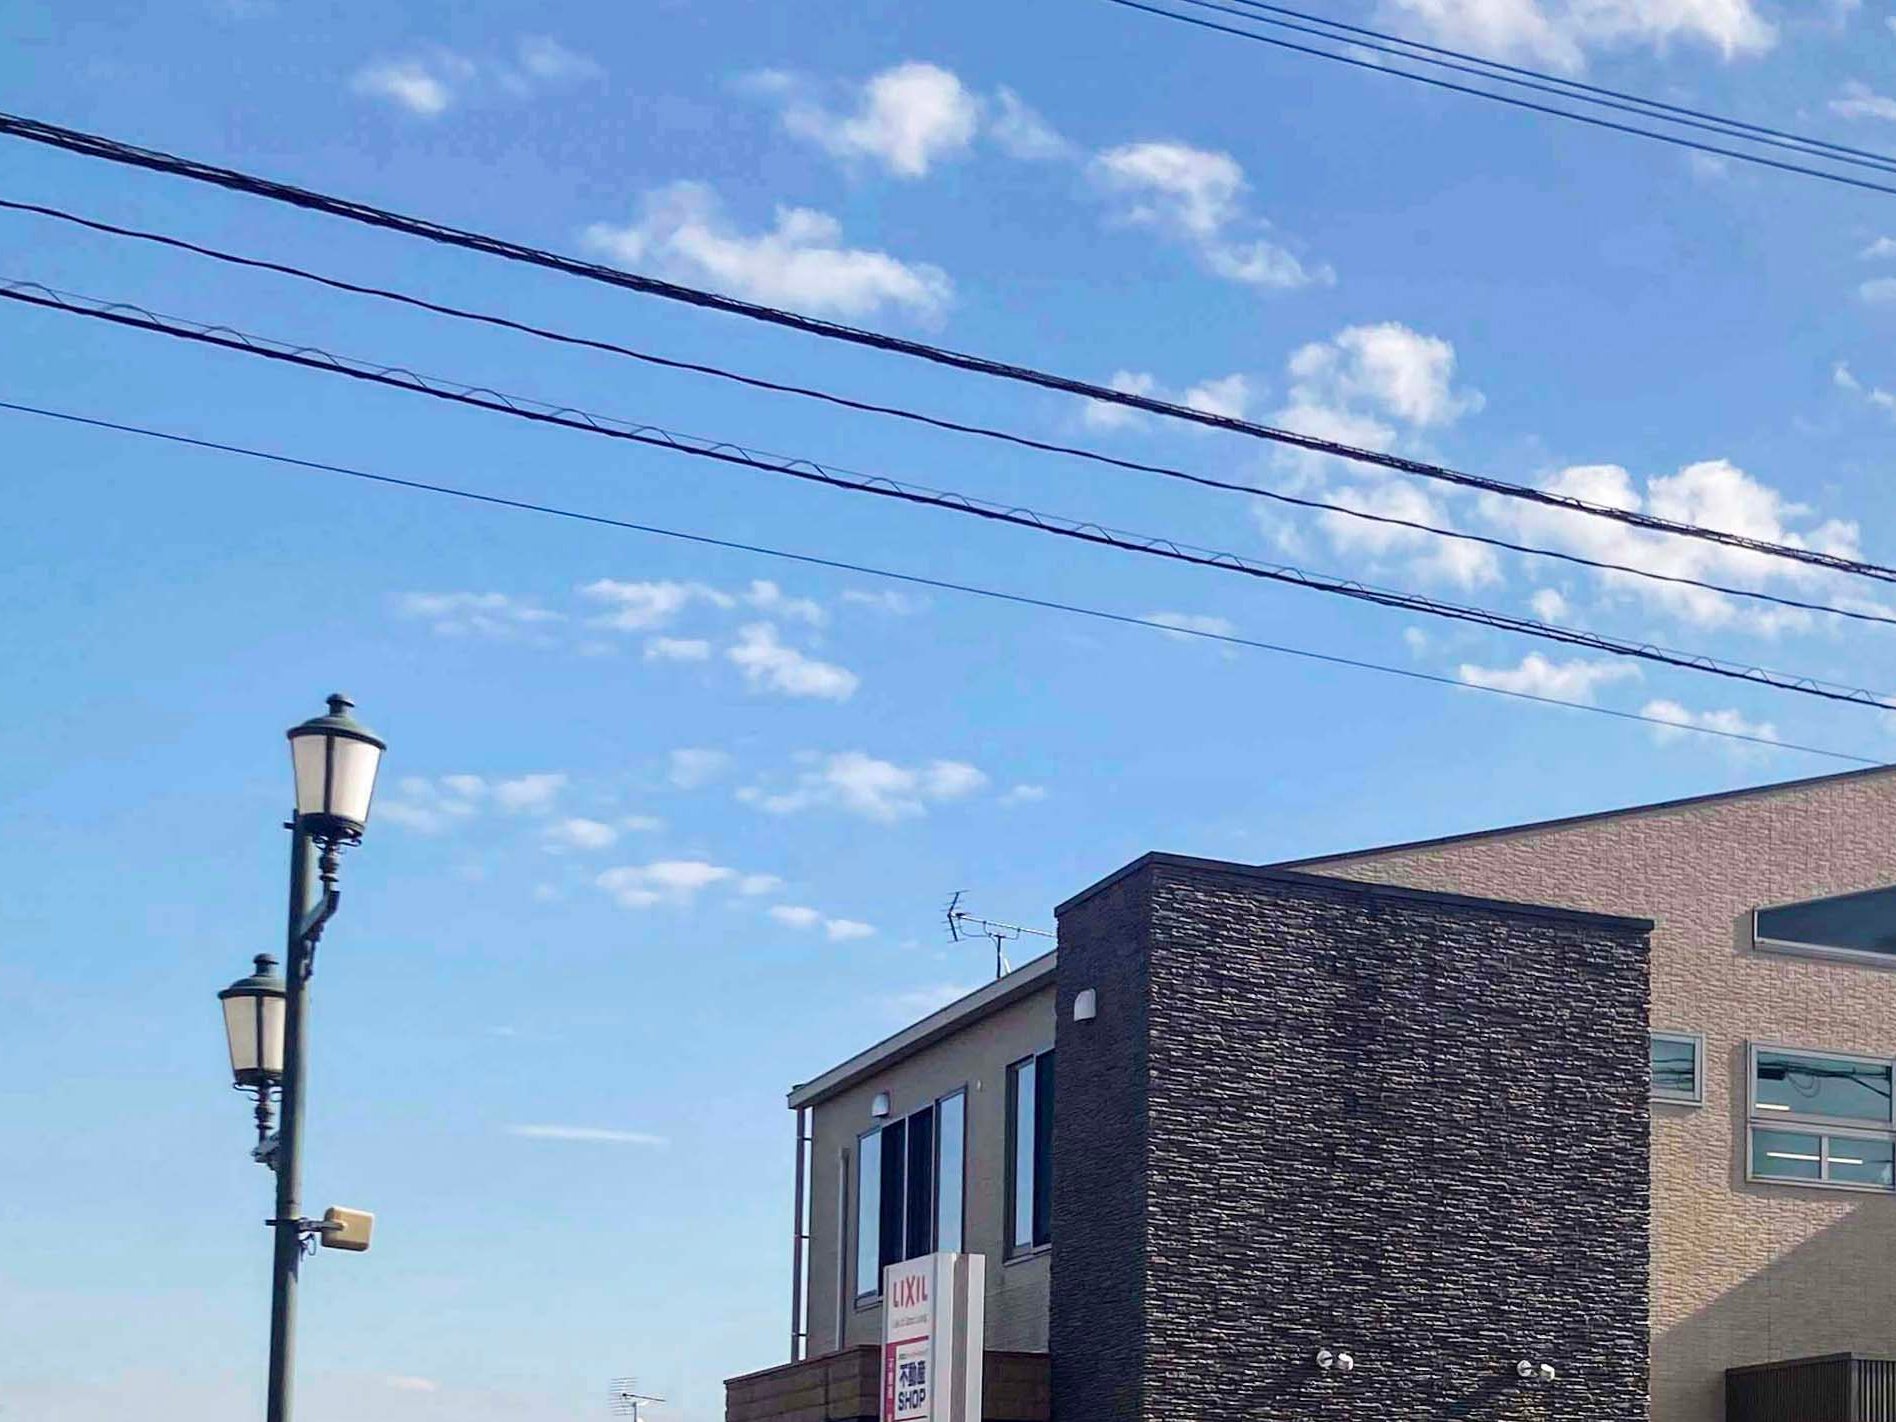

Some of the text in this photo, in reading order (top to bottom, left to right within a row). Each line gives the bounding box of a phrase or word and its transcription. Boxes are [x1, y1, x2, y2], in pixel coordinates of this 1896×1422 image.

[893, 1275, 928, 1308] LIXIL
[899, 1360, 926, 1388] 不動産
[898, 1388, 926, 1411] SHOP
